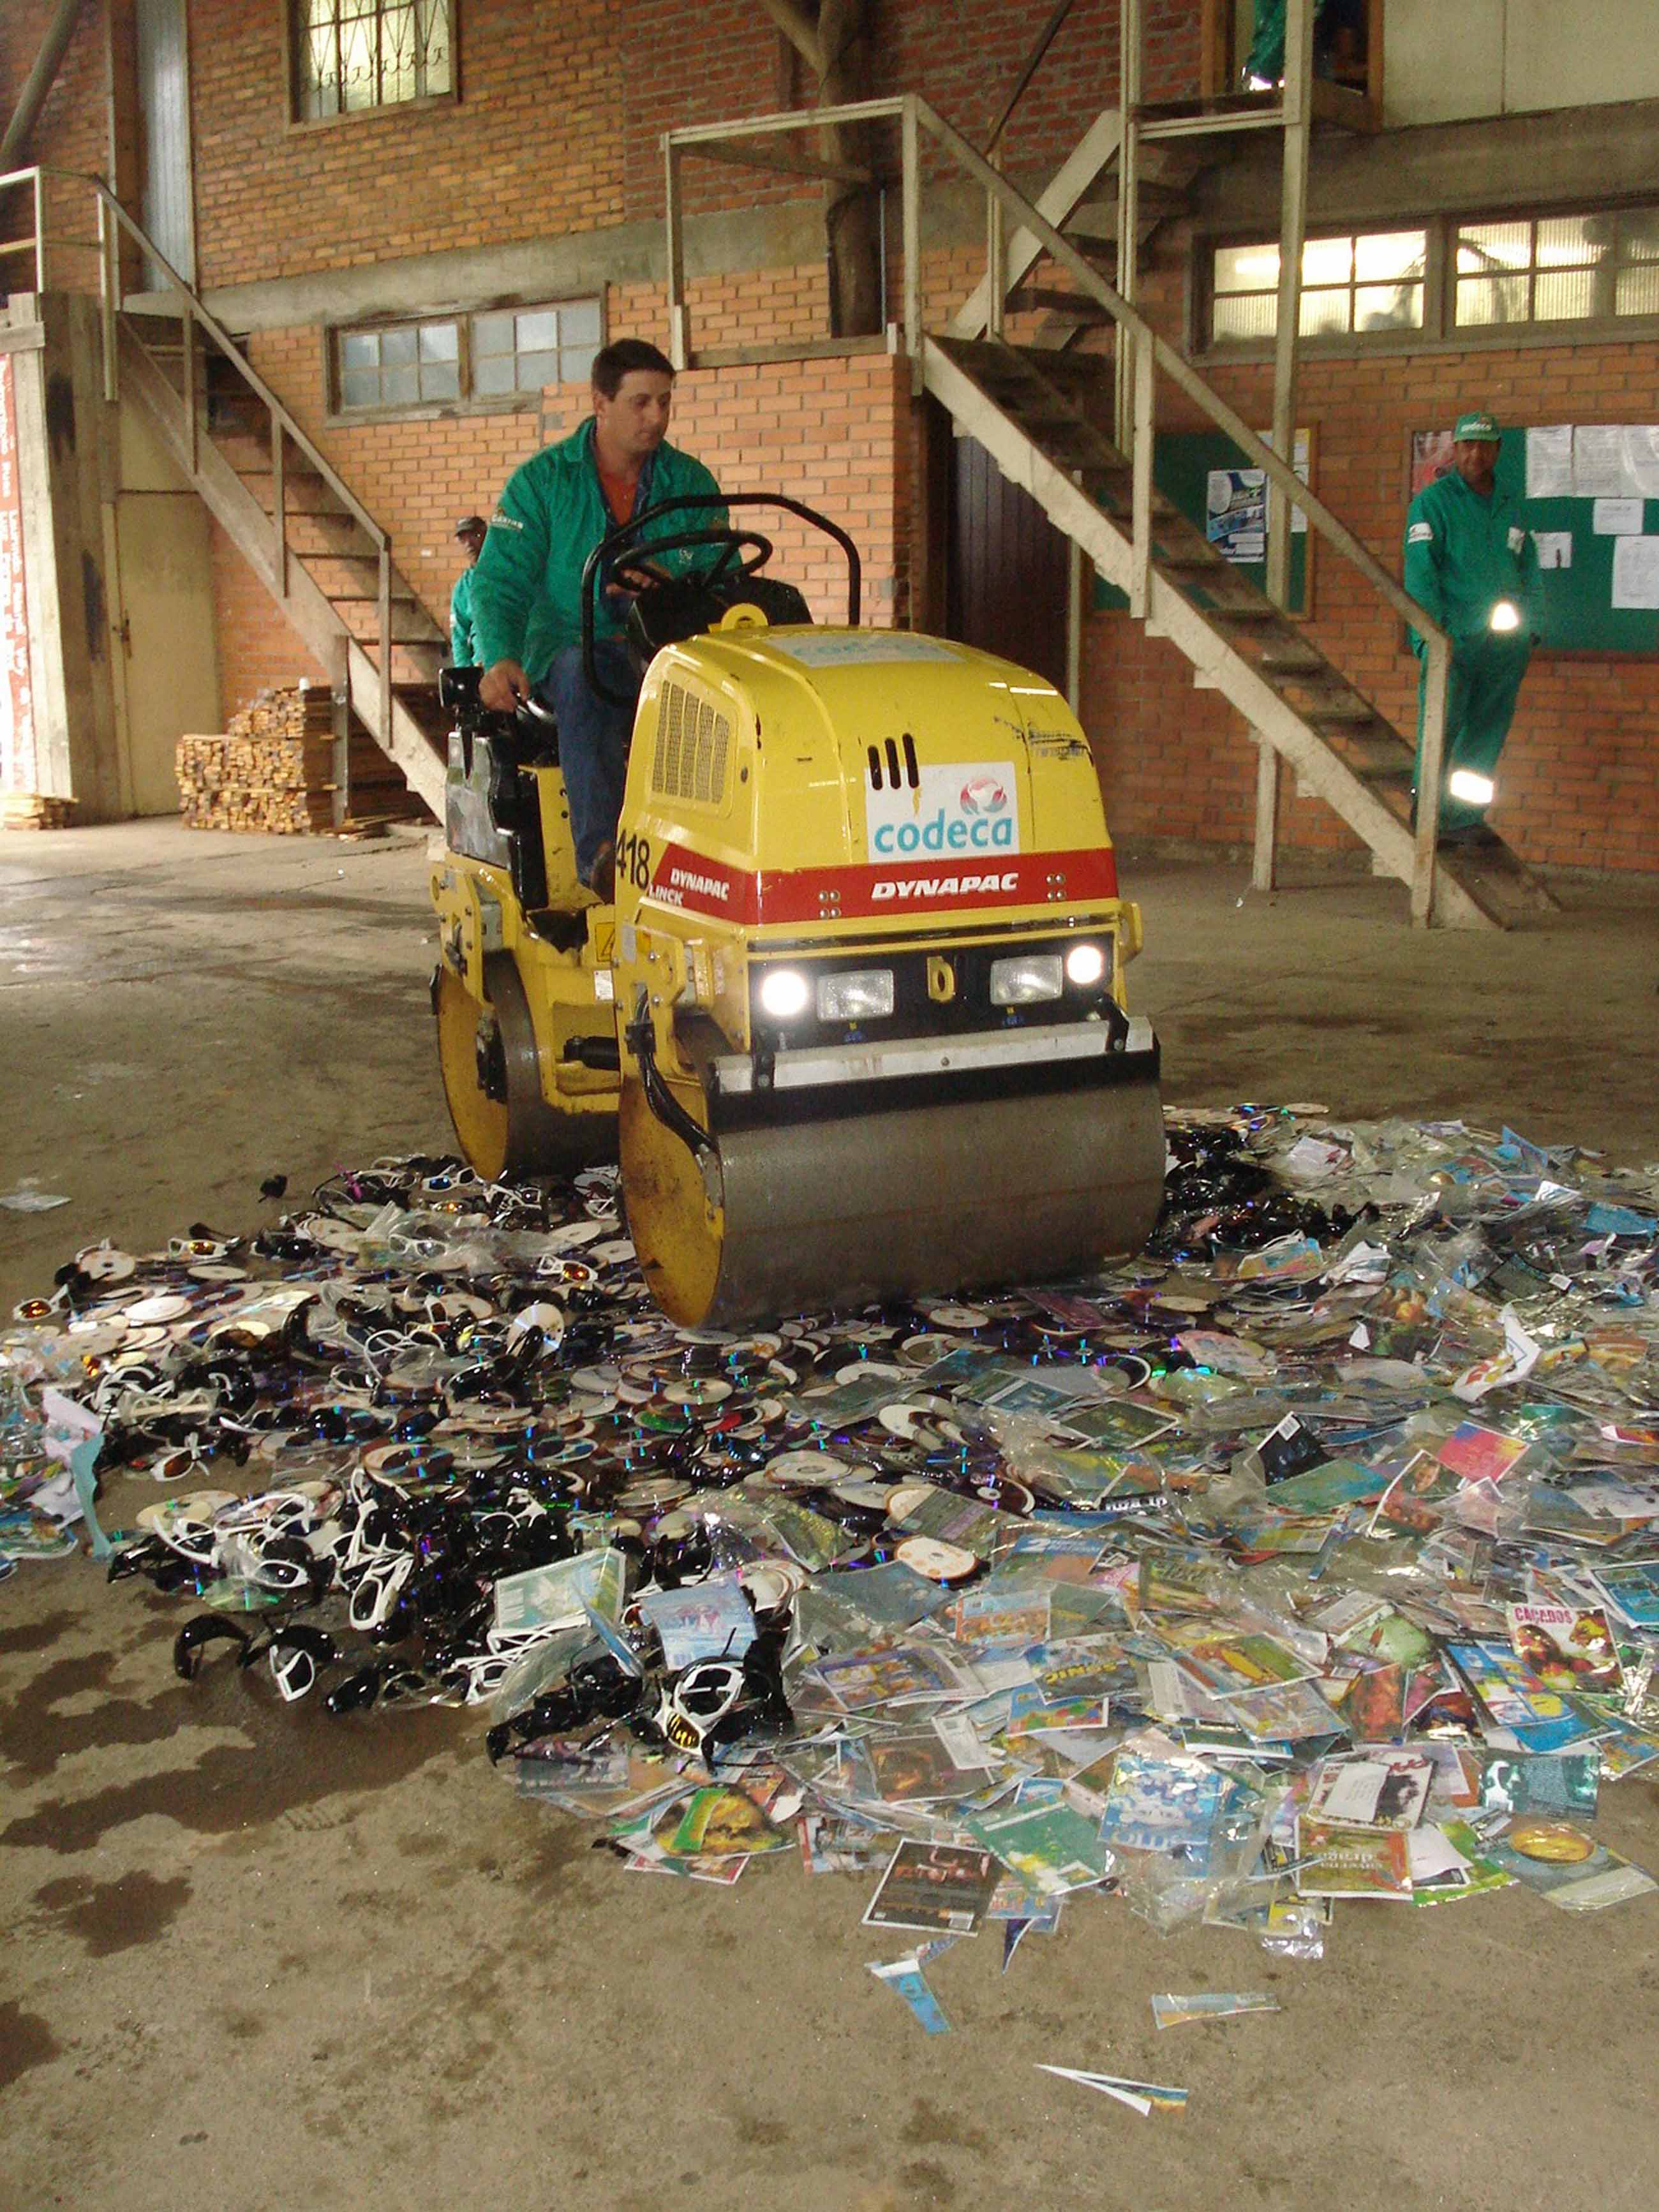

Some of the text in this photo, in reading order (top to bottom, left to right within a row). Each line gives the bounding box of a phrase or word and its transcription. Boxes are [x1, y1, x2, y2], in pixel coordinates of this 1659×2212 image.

[874, 807, 1012, 853] codeca
[616, 829, 650, 890] 418
[648, 882, 684, 907] LINCK
[671, 867, 731, 901] DYNAPAC
[871, 872, 1019, 900] DYNAPAC
